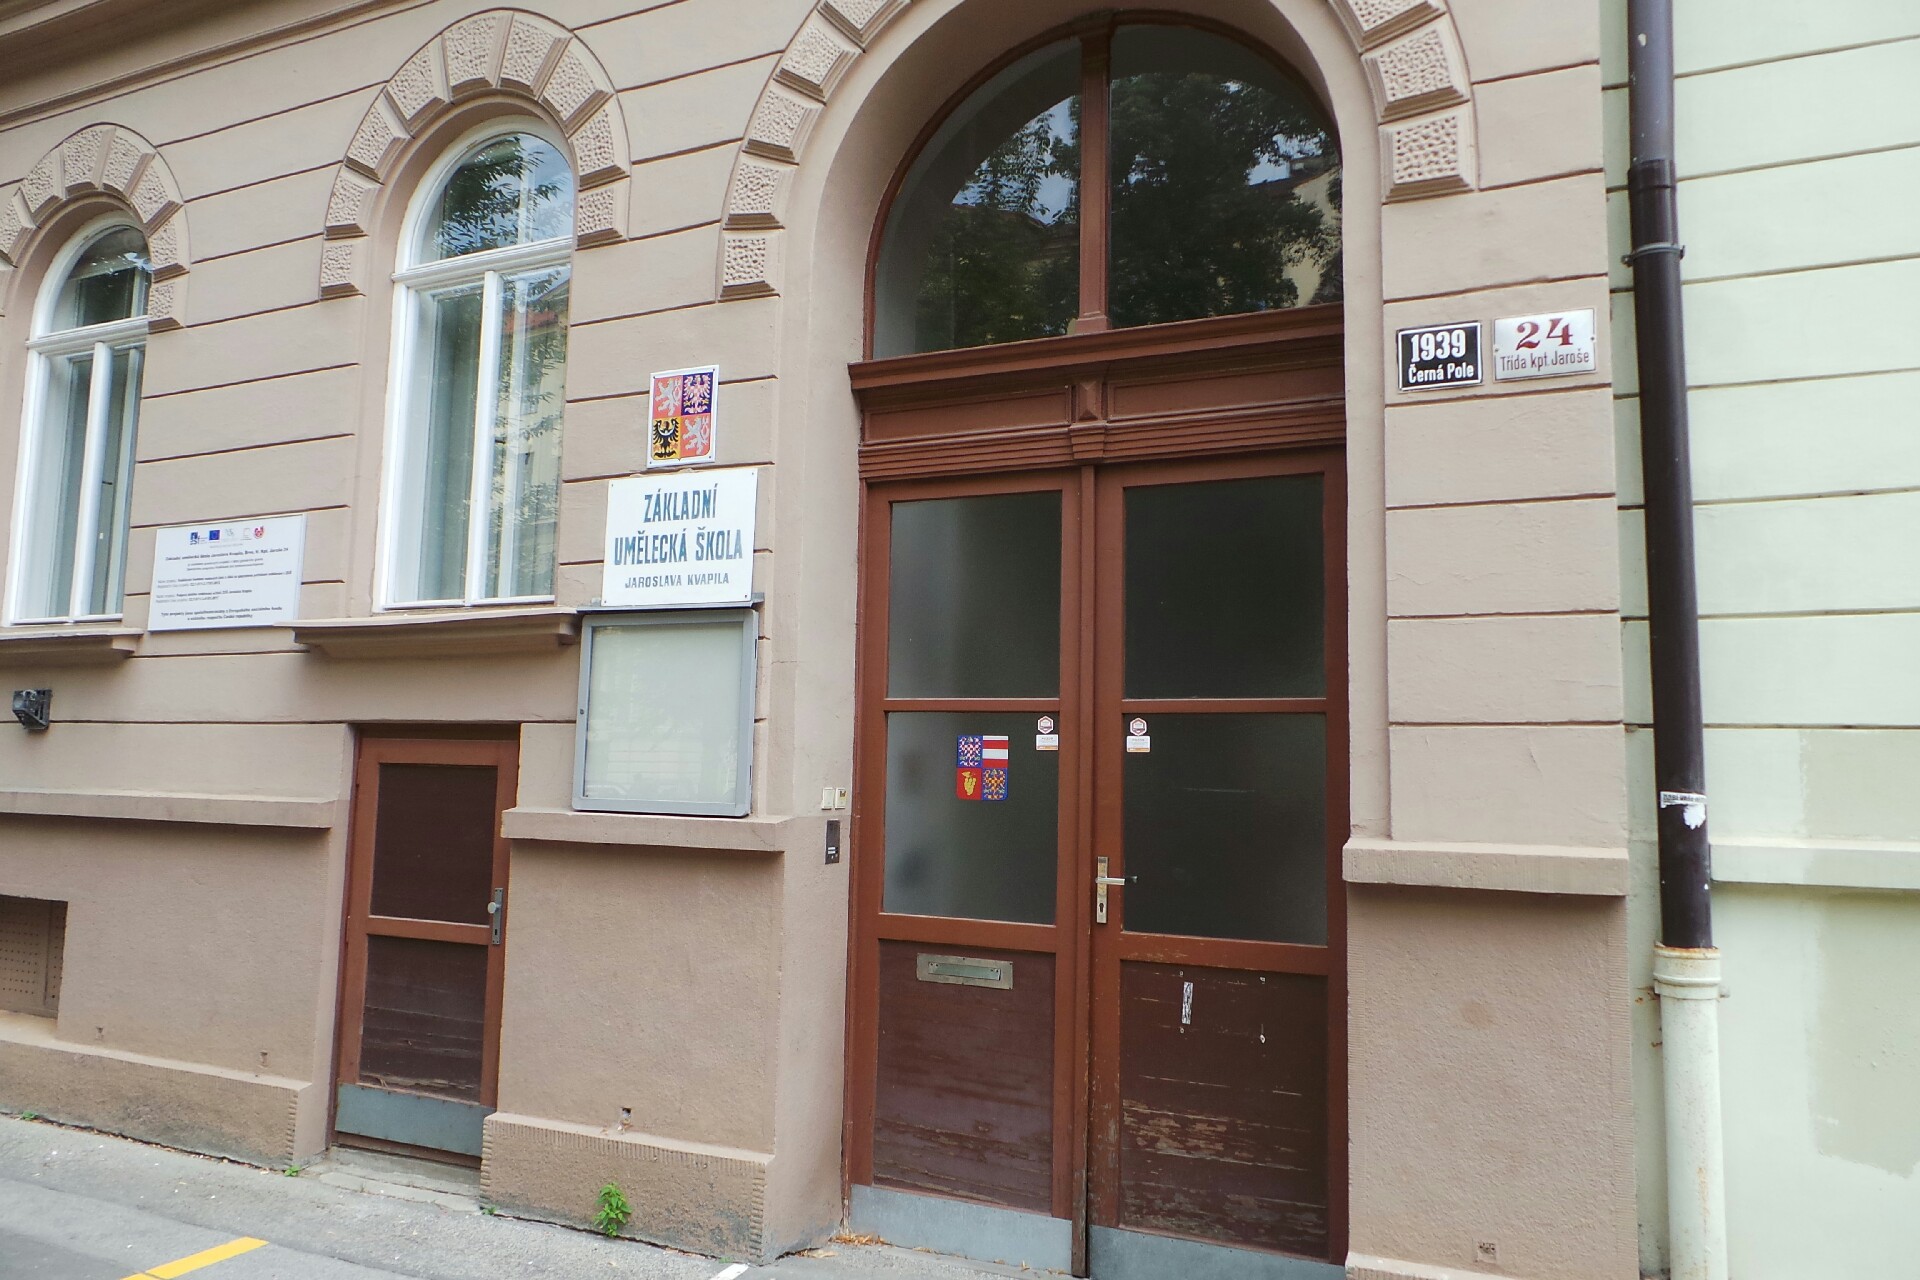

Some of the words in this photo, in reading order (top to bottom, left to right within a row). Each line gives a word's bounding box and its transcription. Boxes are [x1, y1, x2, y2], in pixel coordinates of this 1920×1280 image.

[1410, 329, 1466, 364] 1939
[1516, 317, 1573, 351] 24
[1408, 361, 1444, 384] Černá
[1447, 361, 1474, 380] Pole
[1500, 354, 1526, 372] Třída
[1530, 352, 1550, 372] kpt.
[1552, 348, 1589, 366] Jaroše
[643, 483, 718, 523] ZÁKLADNÍ
[614, 528, 688, 566] UMĚLECKÁ
[695, 526, 743, 561] ŠKOLA
[625, 574, 682, 589] JAROSLAVA
[687, 572, 729, 586] KVAPILA
